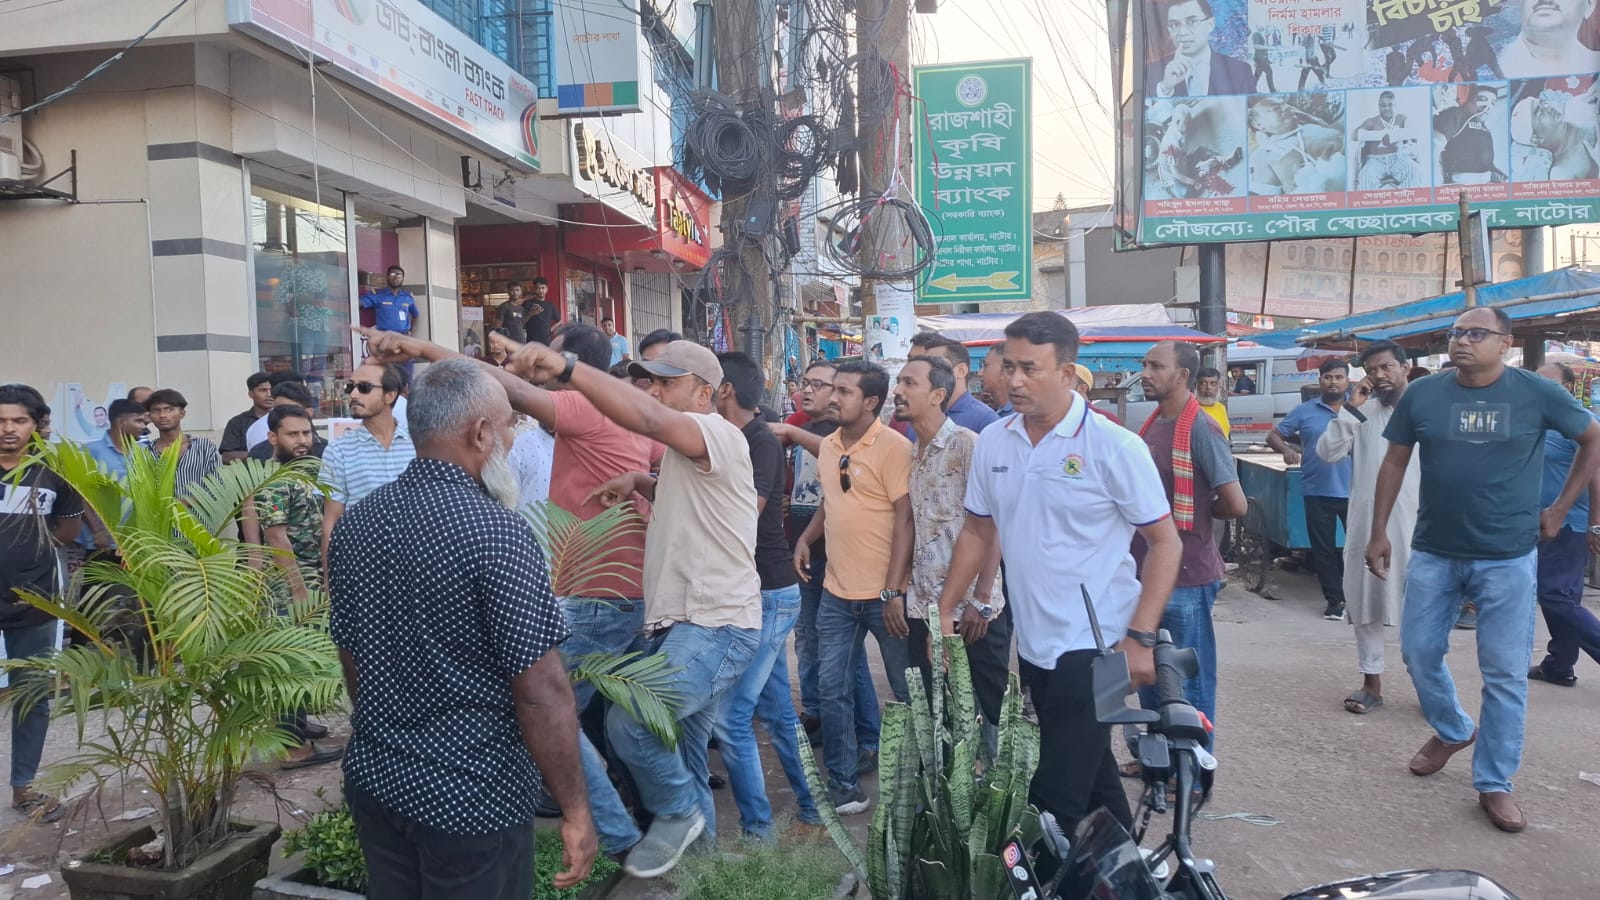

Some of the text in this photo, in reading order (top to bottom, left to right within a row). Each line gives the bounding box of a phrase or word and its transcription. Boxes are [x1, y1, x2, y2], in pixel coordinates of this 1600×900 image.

[1268, 6, 1341, 20] নির্মম হামলার
[1373, 0, 1455, 26] বিচা
[1288, 22, 1322, 36] শিকার
[464, 55, 505, 100] ব্যাংক
[465, 87, 483, 110] FAST
[484, 99, 505, 121] TRACK
[927, 102, 1016, 131] রাজশাহী
[936, 132, 1006, 159] কৃষি
[928, 161, 1017, 181] উন্নয়ন
[930, 186, 1014, 205] ব্যাংক
[1265, 214, 1319, 234] পৌর
[1327, 210, 1456, 232] স্বেচ্ছাসেবক
[1513, 201, 1593, 221] নাটোর
